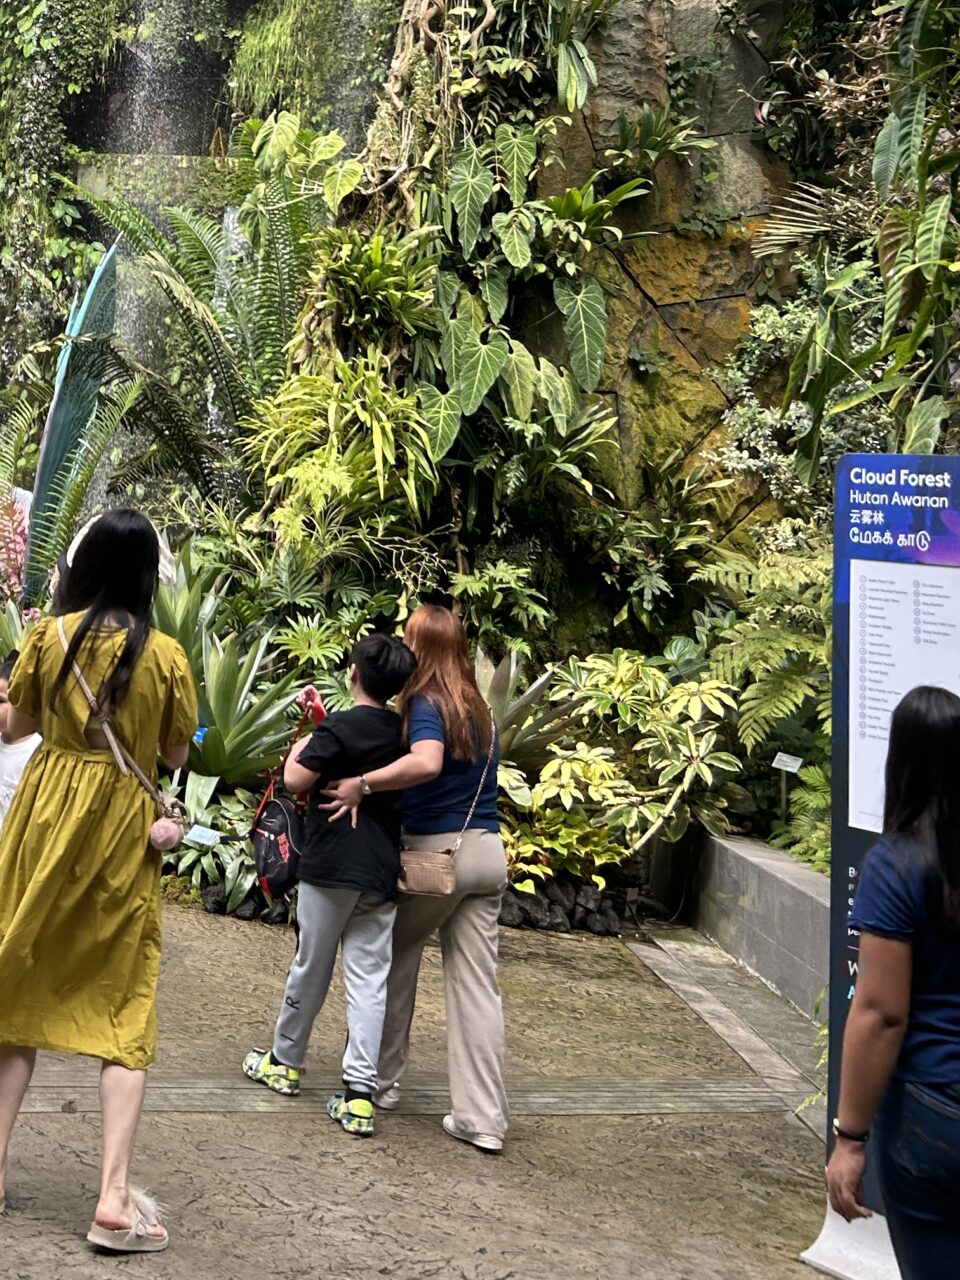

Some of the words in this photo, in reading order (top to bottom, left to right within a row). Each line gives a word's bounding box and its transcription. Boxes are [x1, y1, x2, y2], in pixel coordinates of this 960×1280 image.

[850, 467, 896, 485] Cloud
[900, 469, 951, 487] Forest
[850, 489, 888, 505] Hutan
[891, 491, 948, 508] Awanan
[849, 509, 884, 525] 云雾林
[897, 531, 931, 551] காடு
